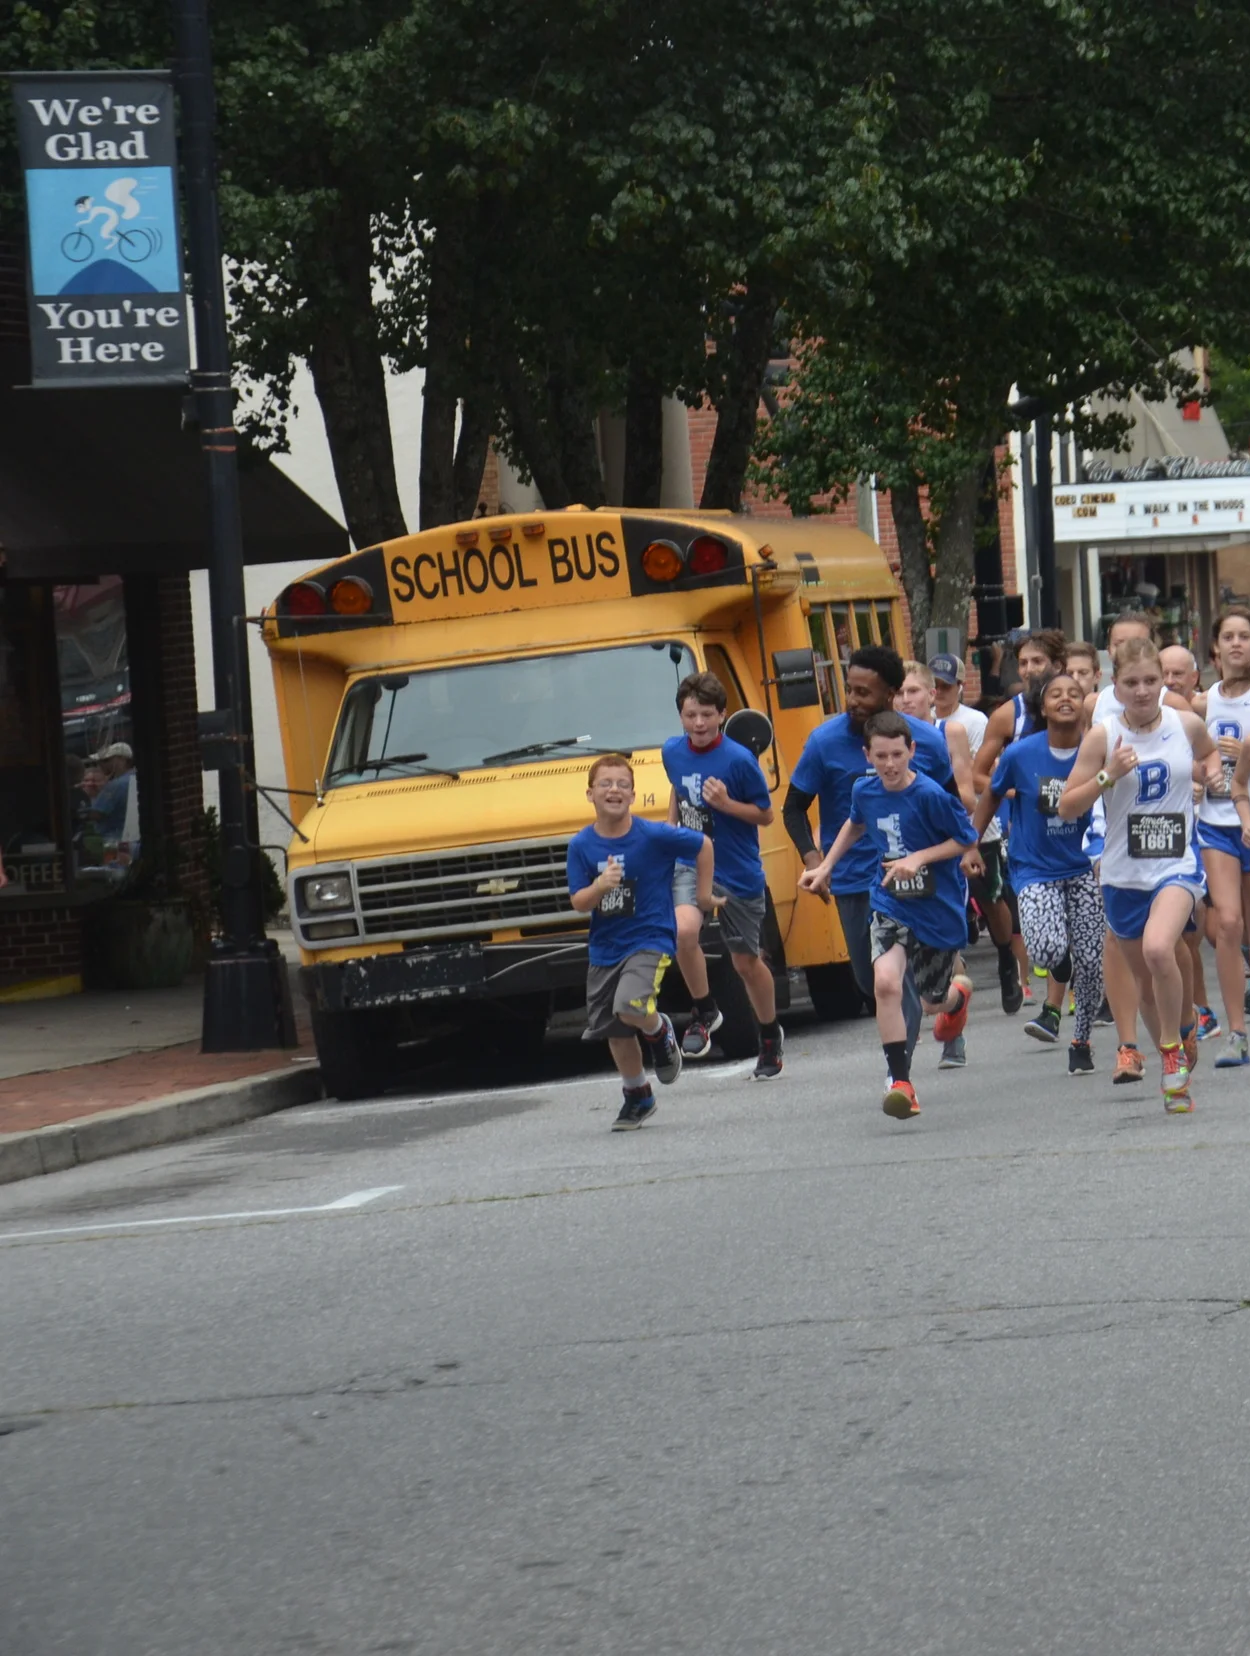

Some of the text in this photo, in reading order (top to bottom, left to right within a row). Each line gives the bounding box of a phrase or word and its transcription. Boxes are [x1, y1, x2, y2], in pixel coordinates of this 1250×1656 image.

[28, 97, 161, 127] We're
[45, 131, 149, 161] Glad
[36, 300, 181, 330] You're
[57, 337, 165, 364] Here
[1080, 492, 1116, 504] CINEMA
[1128, 504, 1136, 515] A
[1143, 503, 1170, 515] WALK
[1177, 501, 1188, 513] IN
[1193, 500, 1209, 512] THE
[1213, 498, 1245, 512] WOODS
[391, 531, 620, 603] SCHOOL BUS
[1137, 759, 1170, 805] B
[643, 792, 655, 807] 14
[4, 862, 63, 885] OFFEE
